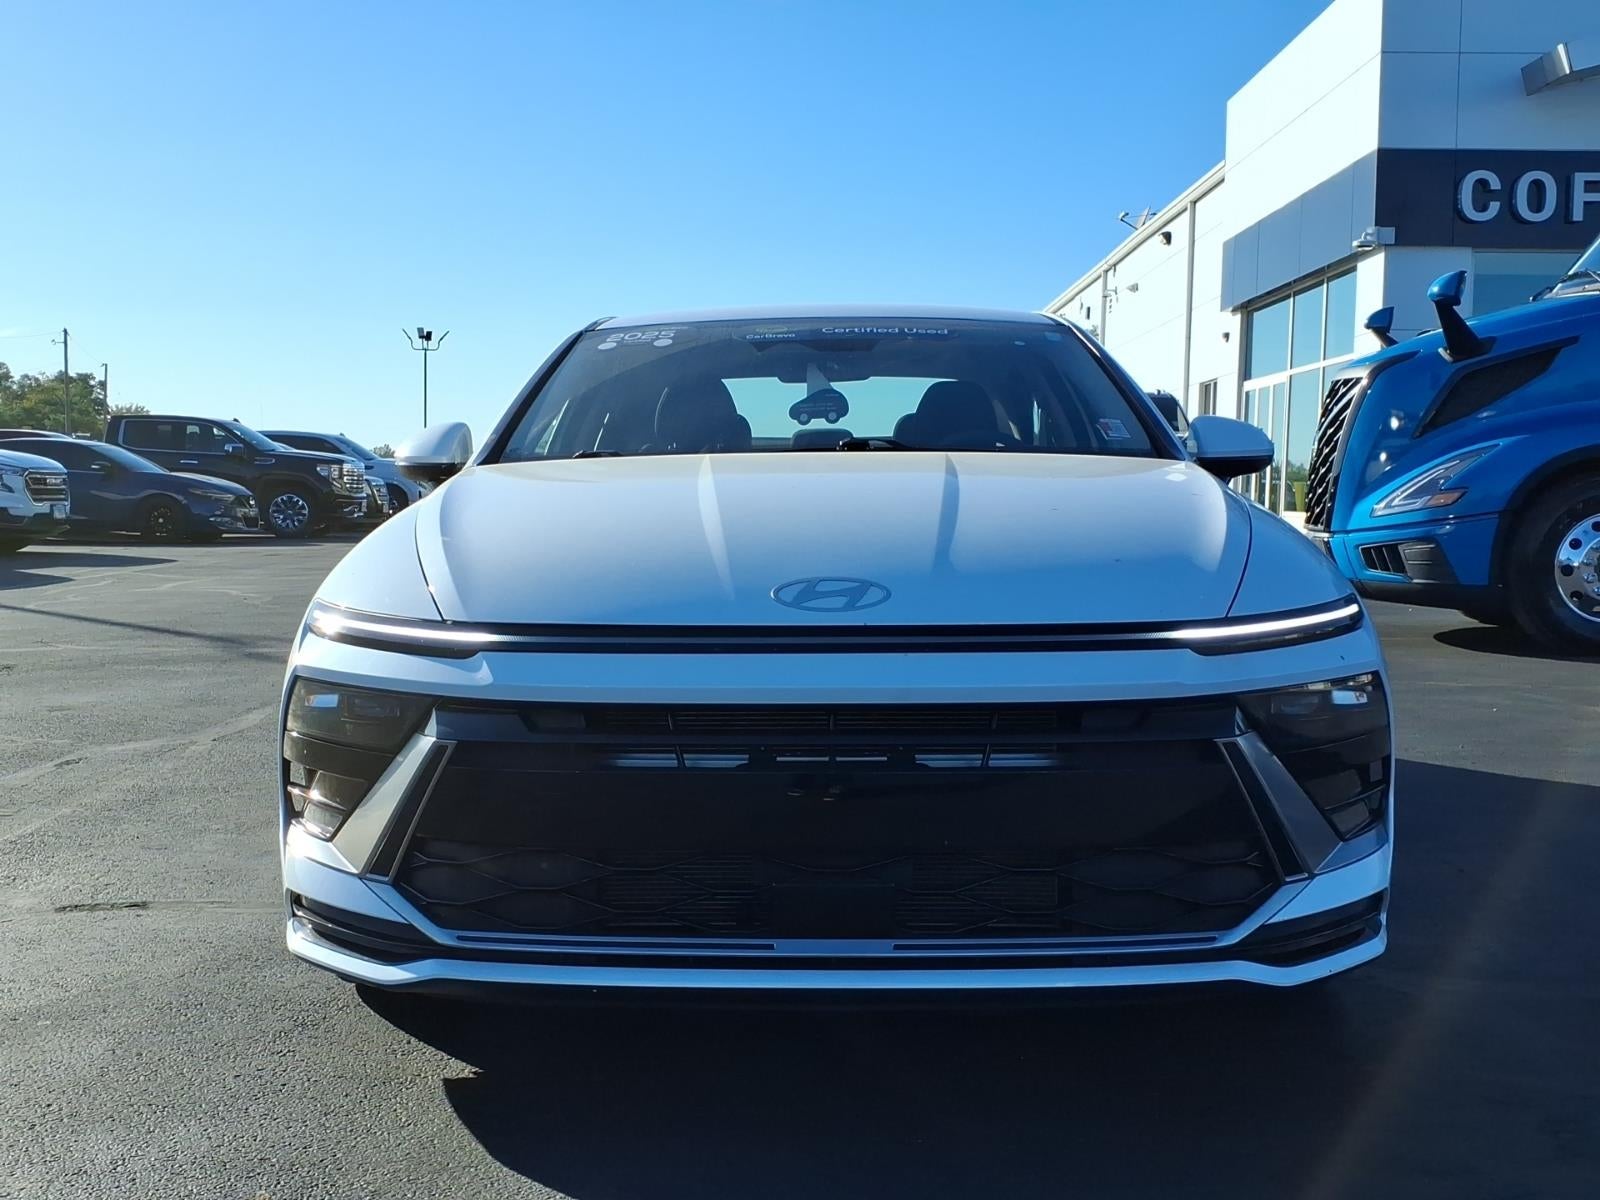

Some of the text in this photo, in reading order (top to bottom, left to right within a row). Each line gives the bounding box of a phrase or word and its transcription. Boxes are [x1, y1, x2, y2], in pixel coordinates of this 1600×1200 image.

[822, 326, 949, 335] Certified Used
[606, 330, 677, 342] 2025
